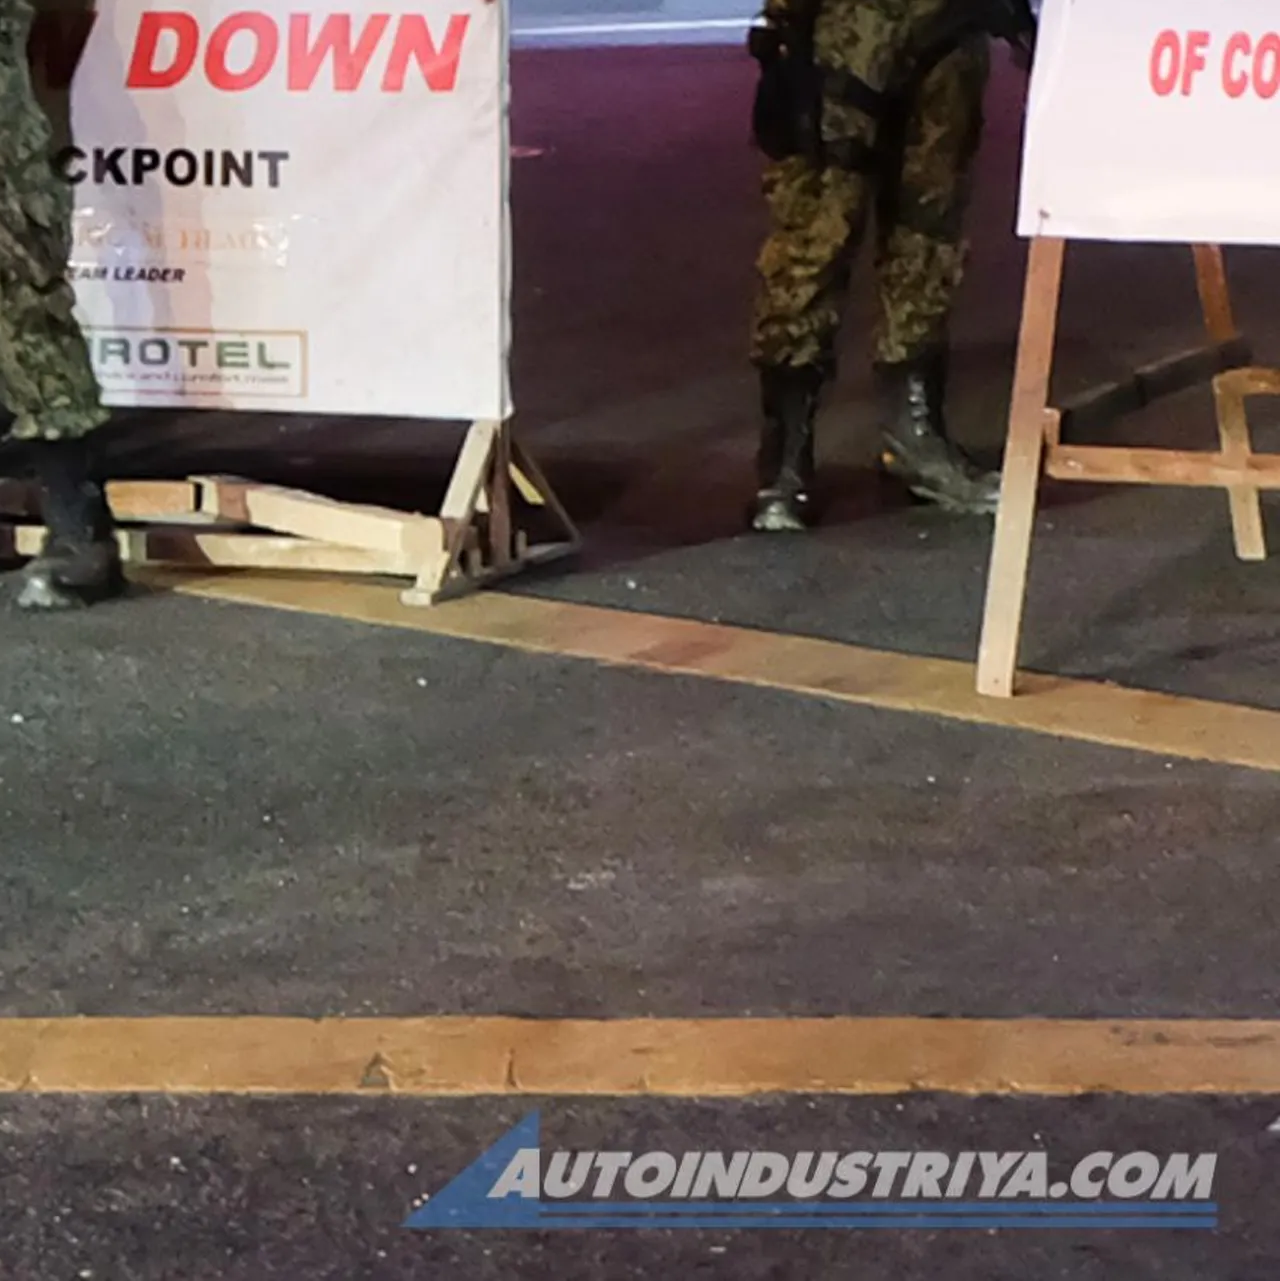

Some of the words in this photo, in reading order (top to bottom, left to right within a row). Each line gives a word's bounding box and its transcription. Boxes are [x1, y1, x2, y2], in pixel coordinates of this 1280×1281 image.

[125, 10, 471, 92] DOWN
[1150, 28, 1210, 97] OF
[52, 147, 290, 187] CKPOINT
[67, 267, 108, 281] EAM
[113, 267, 187, 282] LEADER
[96, 338, 291, 369] ROTEL
